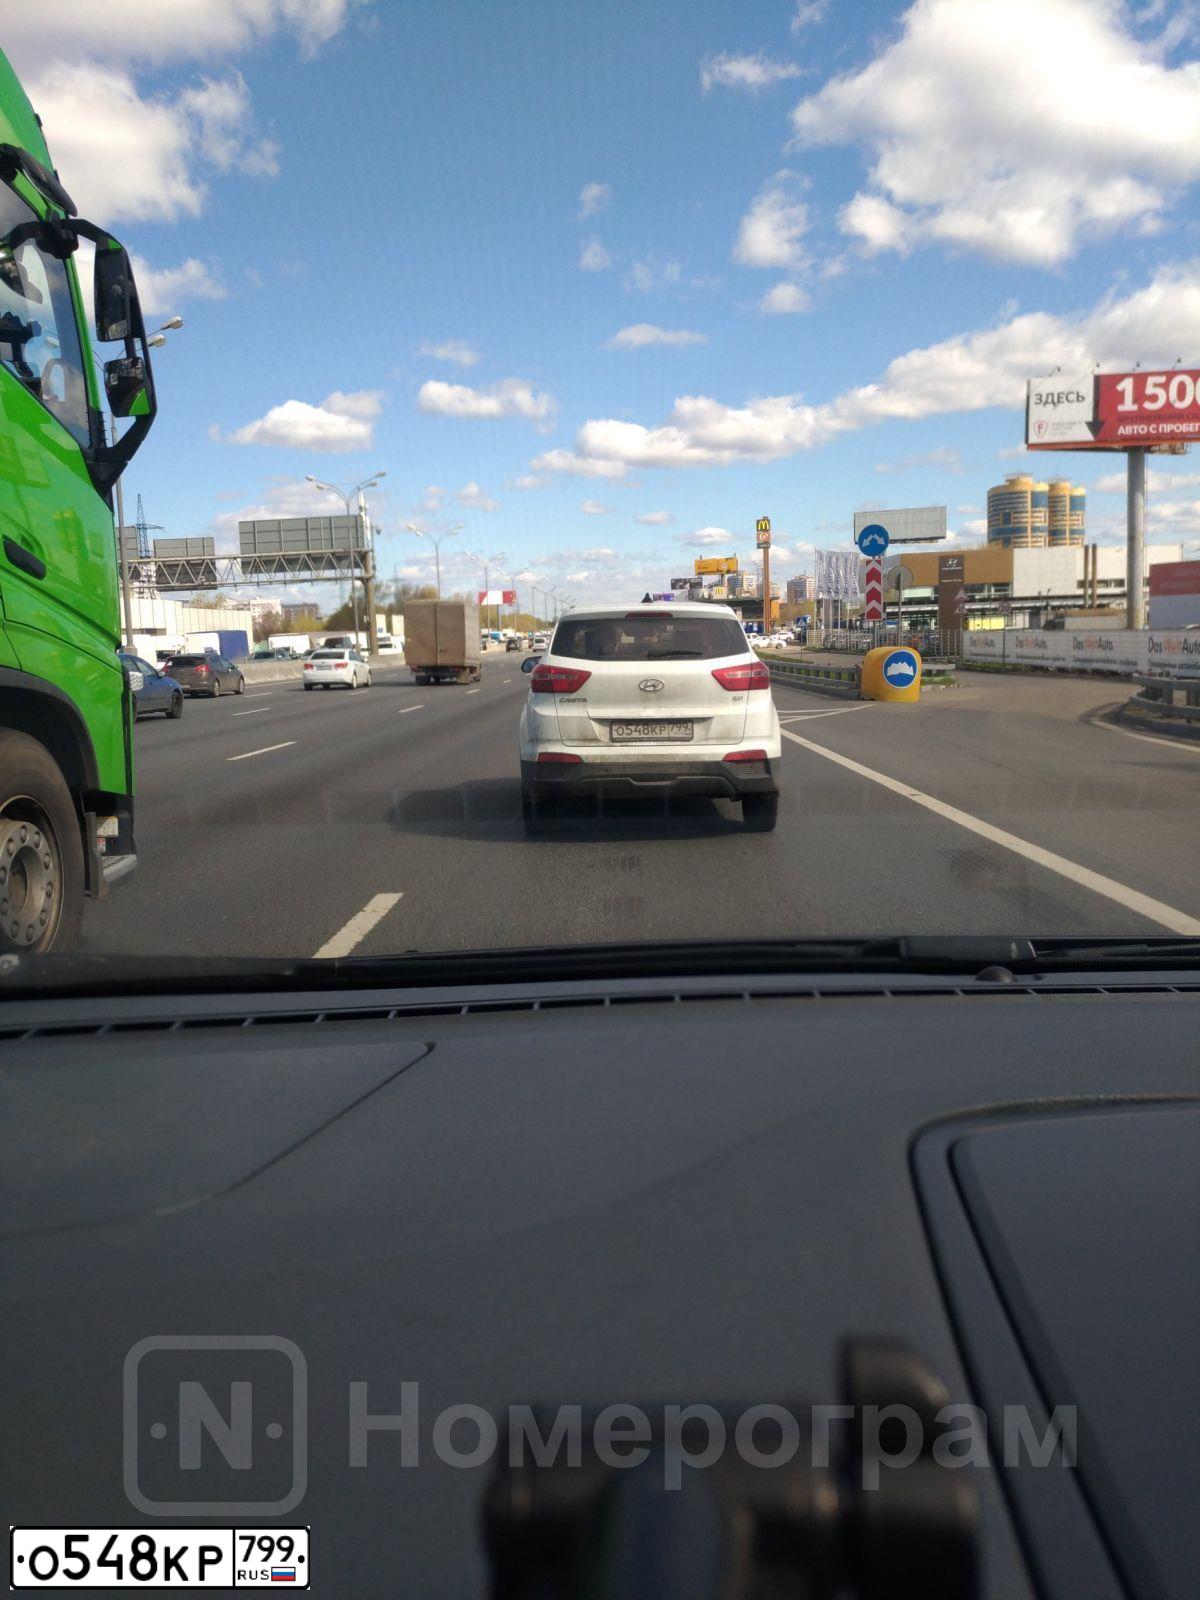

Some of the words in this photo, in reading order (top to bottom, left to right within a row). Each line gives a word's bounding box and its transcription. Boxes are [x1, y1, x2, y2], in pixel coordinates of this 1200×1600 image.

[1034, 391, 1085, 408] ЗДЕСЬ
[1117, 424, 1148, 435] АВТО
[1149, 424, 1157, 434] С
[1148, 636, 1163, 653] Das
